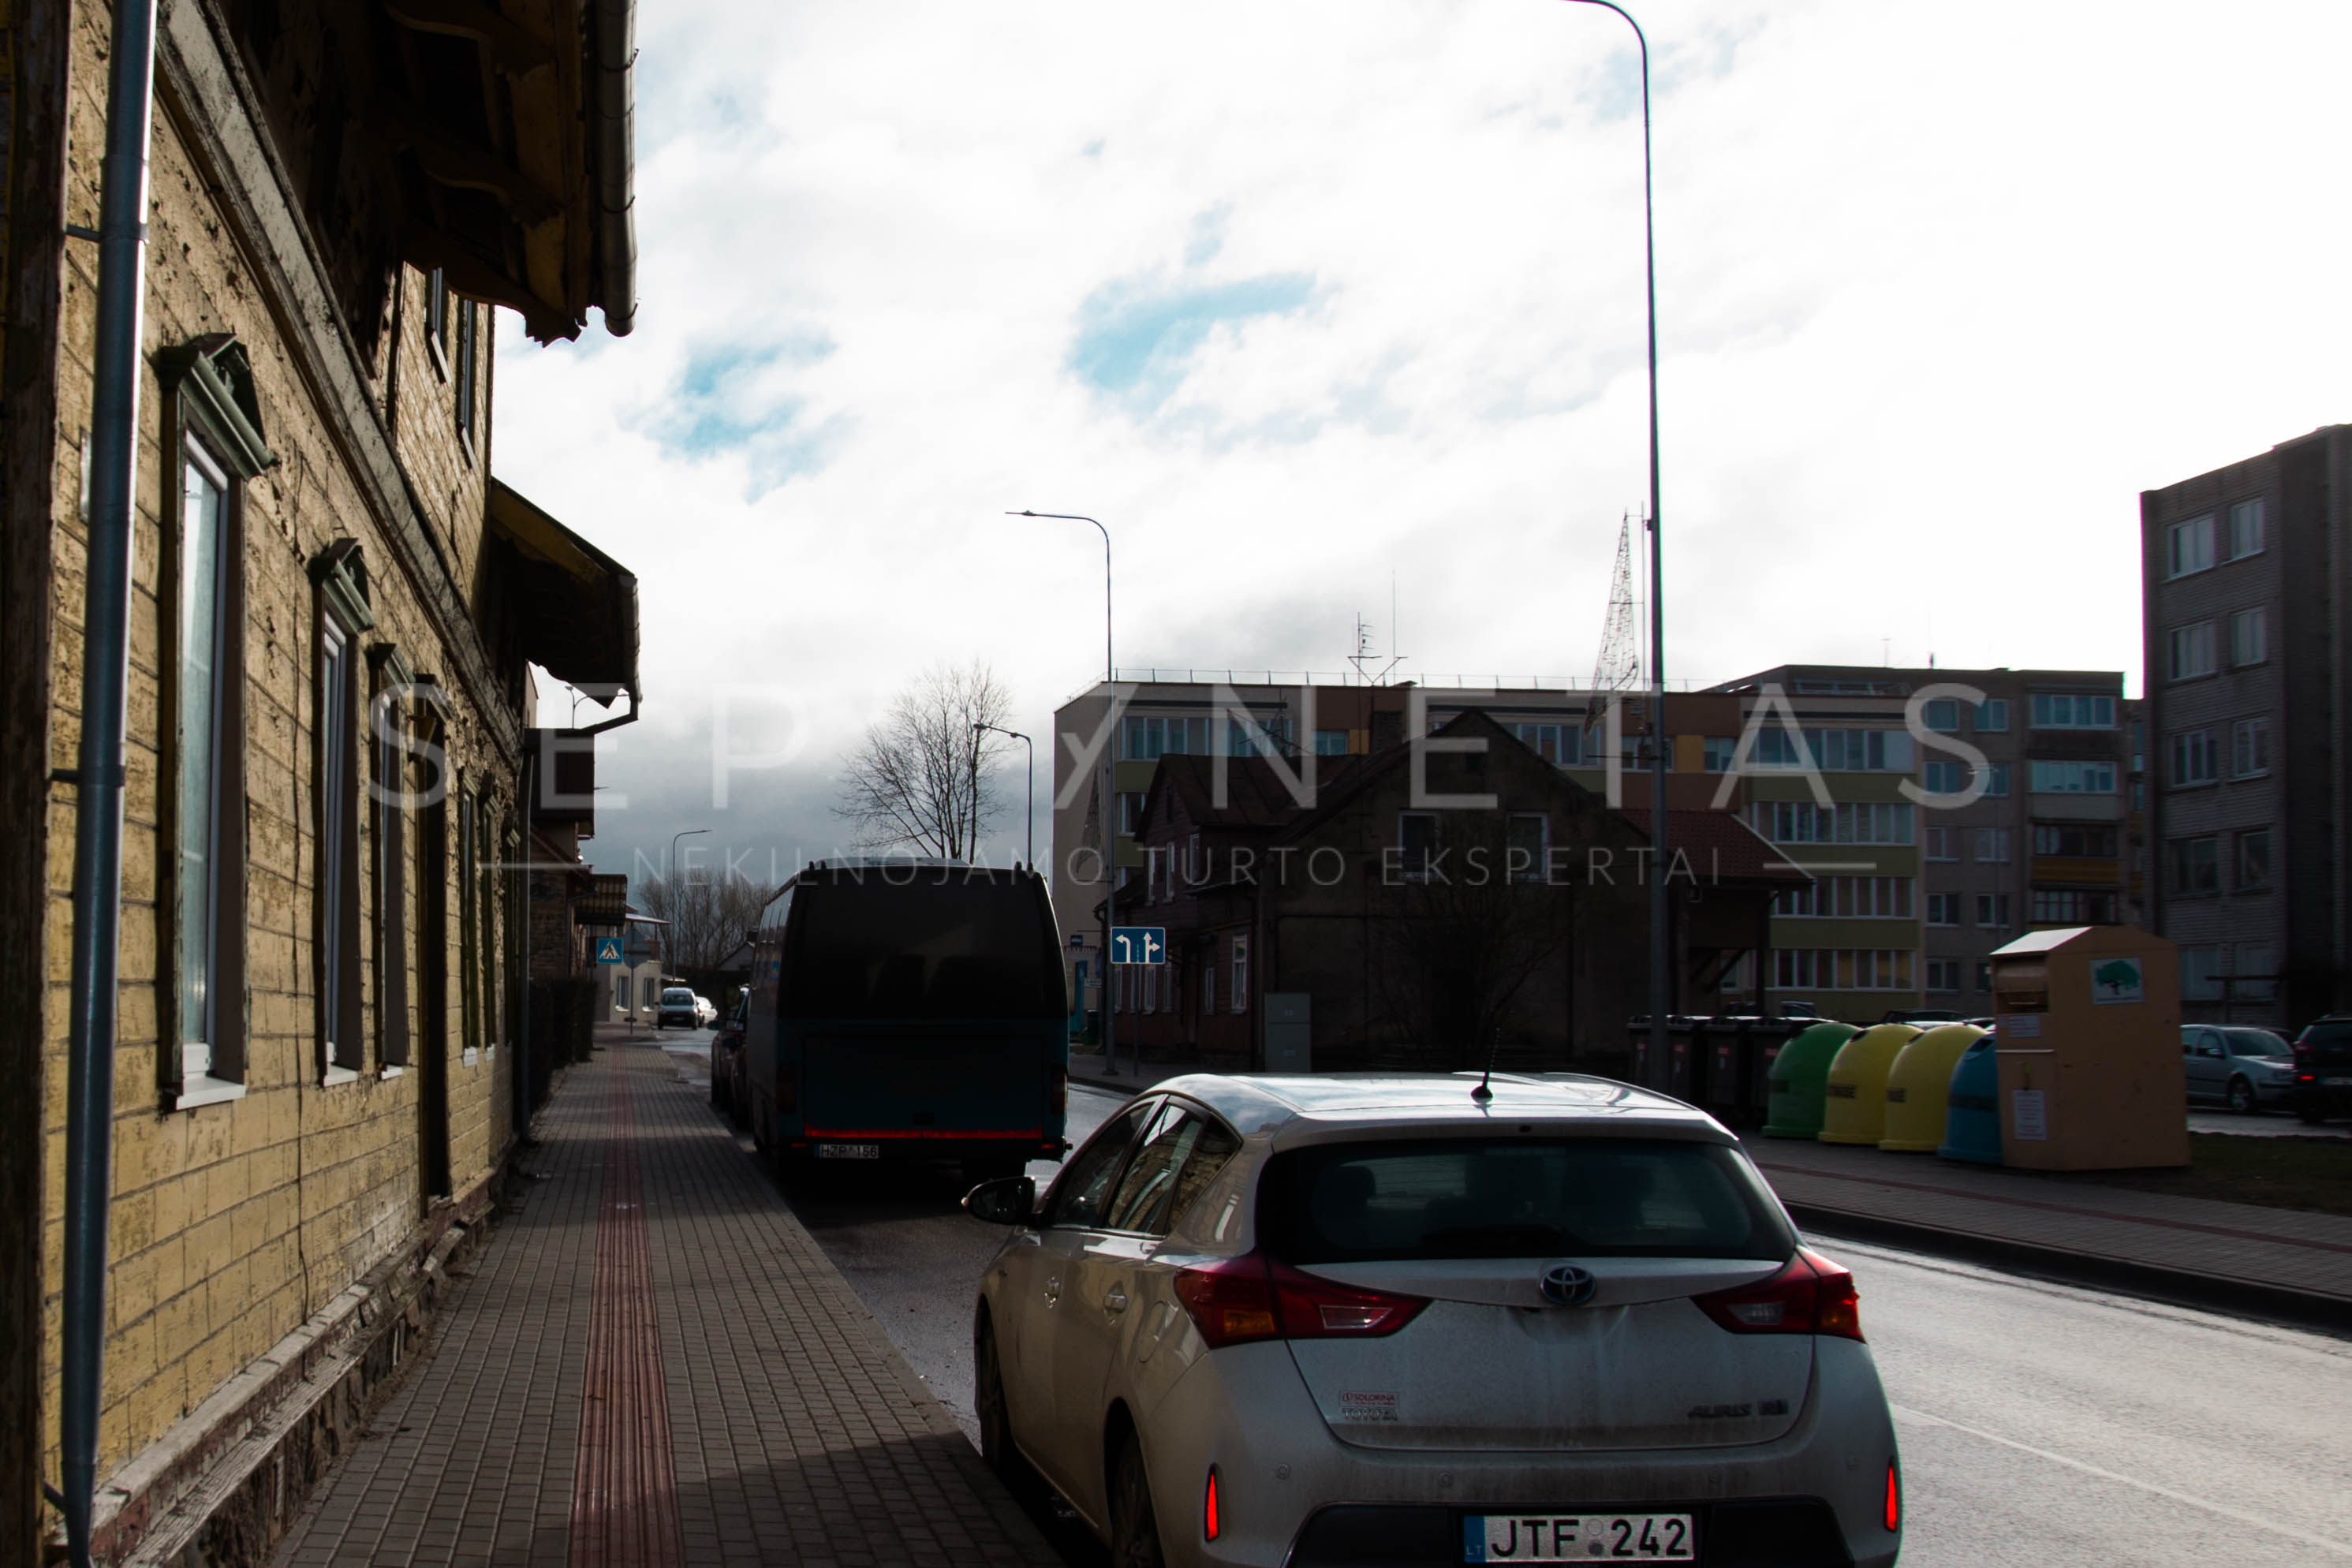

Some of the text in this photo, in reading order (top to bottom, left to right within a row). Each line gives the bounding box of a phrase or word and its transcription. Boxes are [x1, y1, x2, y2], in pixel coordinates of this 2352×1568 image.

[1342, 1408, 1398, 1421] TOYOTA
[1491, 1518, 1688, 1557] JTF 242
[1466, 1545, 1483, 1555] LT
